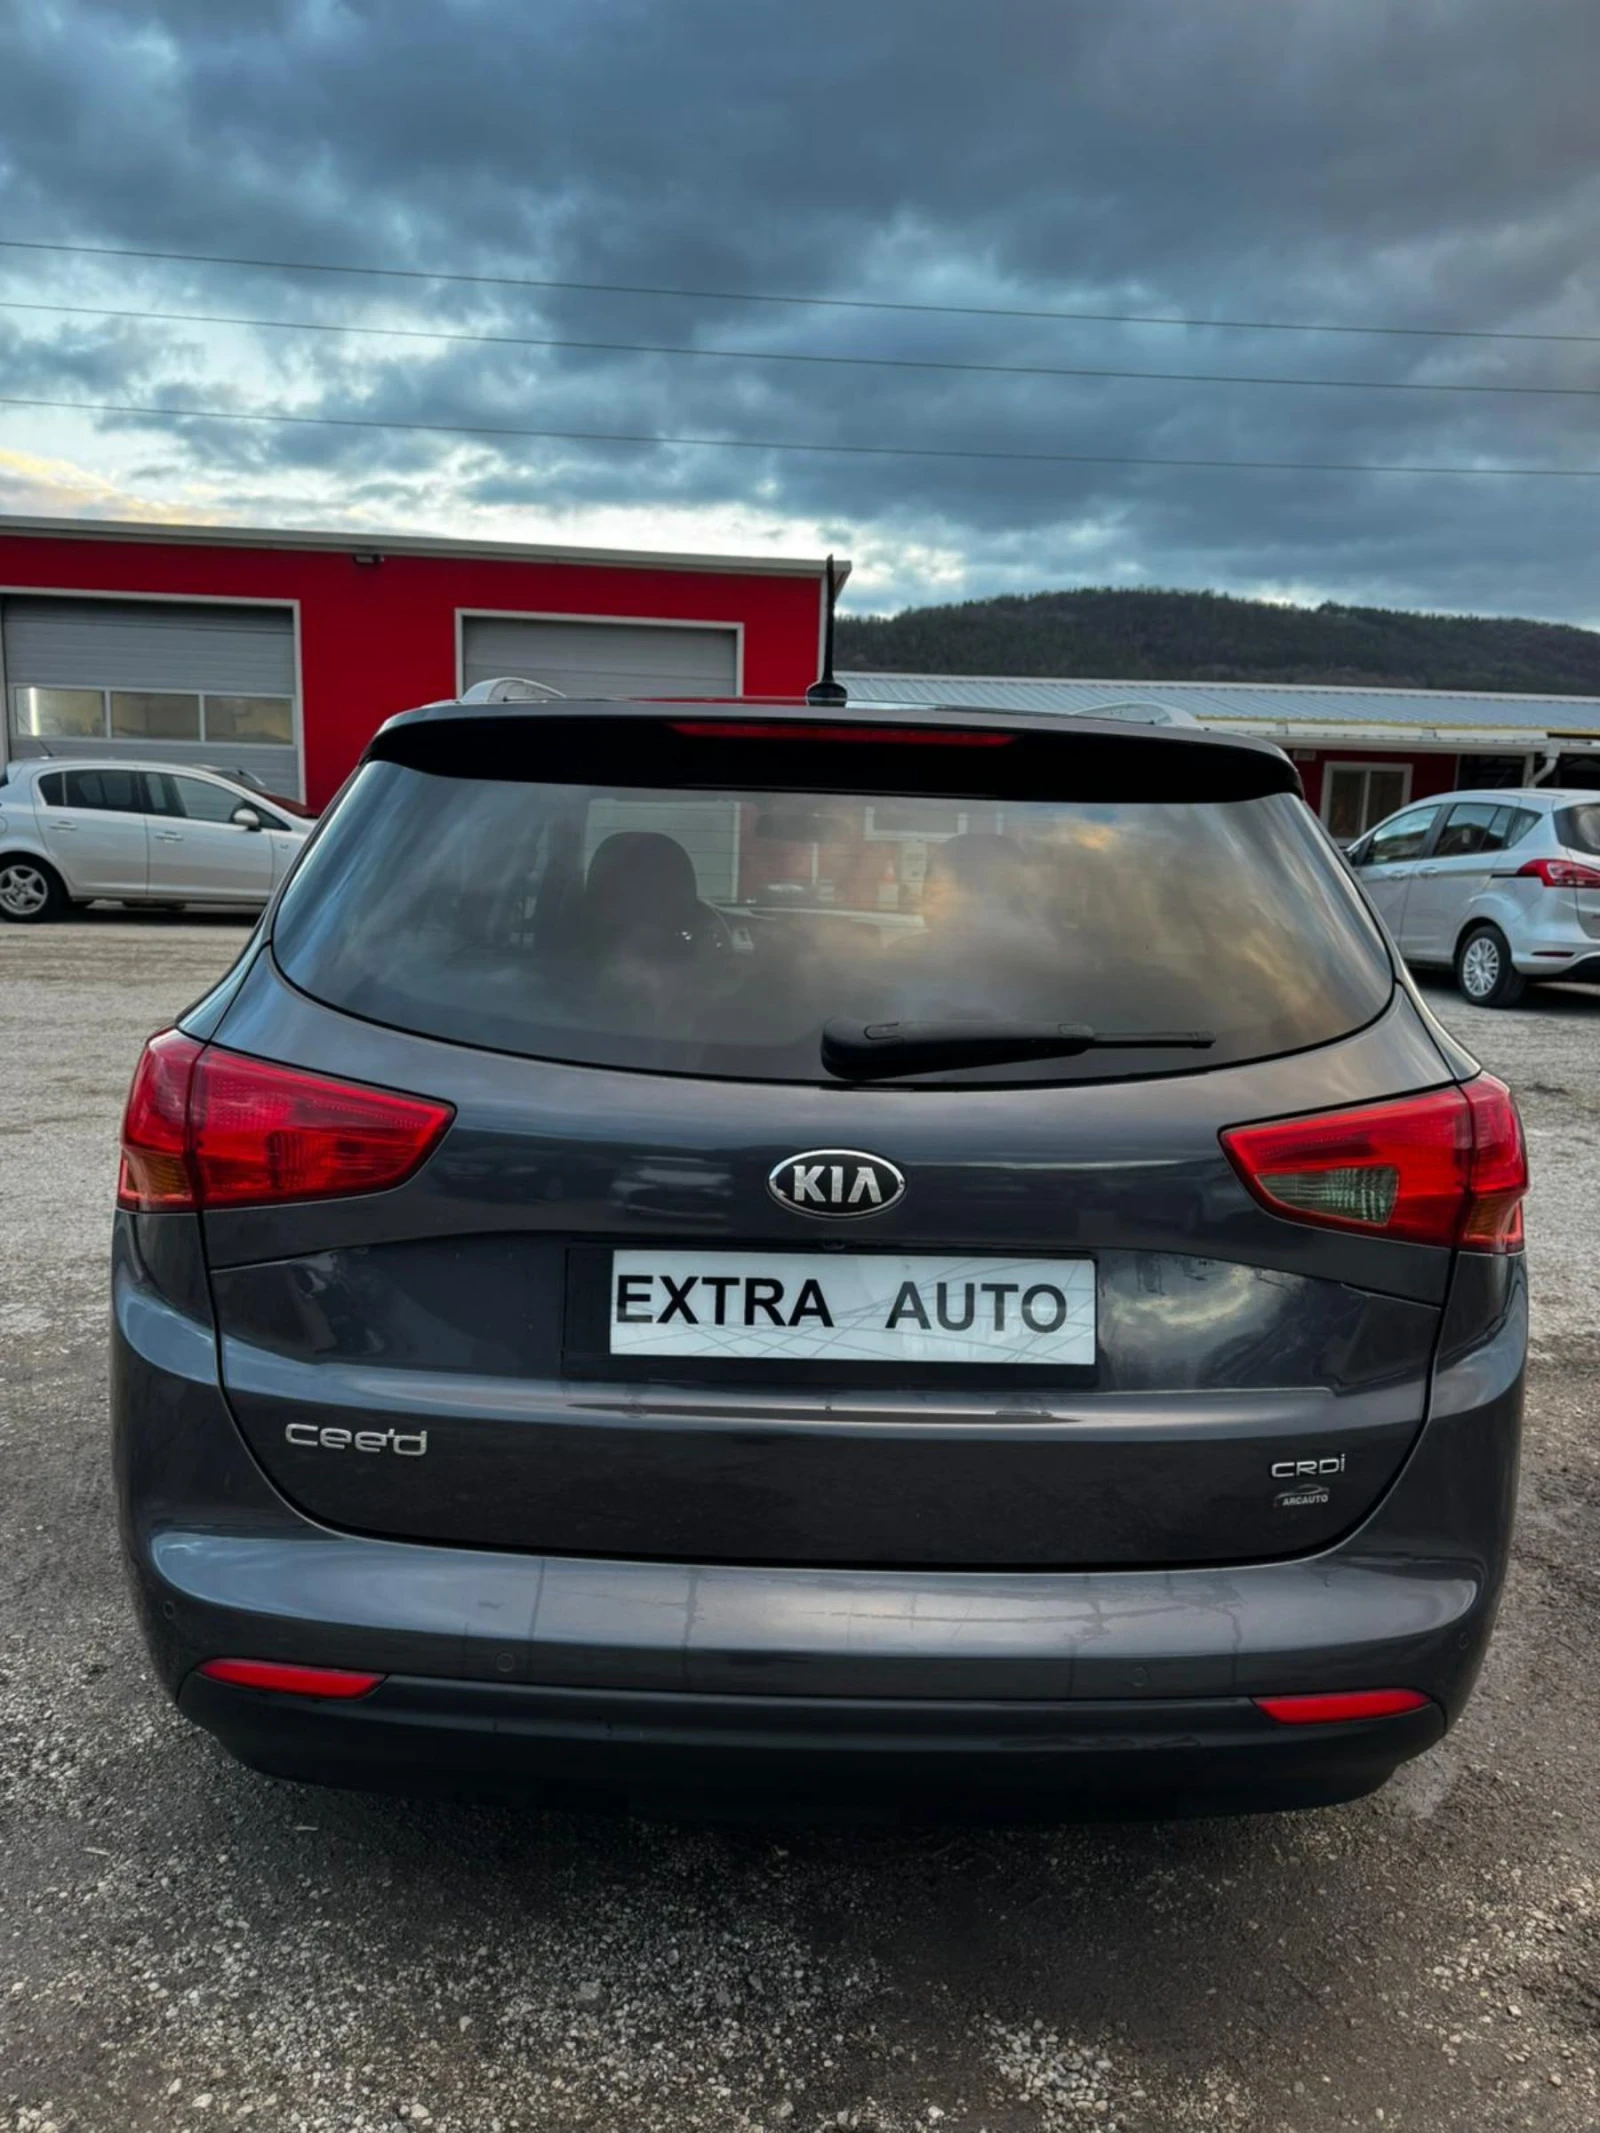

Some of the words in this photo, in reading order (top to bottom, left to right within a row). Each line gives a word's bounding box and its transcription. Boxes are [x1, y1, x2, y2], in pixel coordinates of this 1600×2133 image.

[793, 1165, 883, 1203] KIA
[616, 1275, 834, 1328] EXTRA
[885, 1281, 1068, 1334] AUTO
[1271, 1453, 1345, 1477] CRDi
[1282, 1494, 1328, 1506] ARCAUTO
